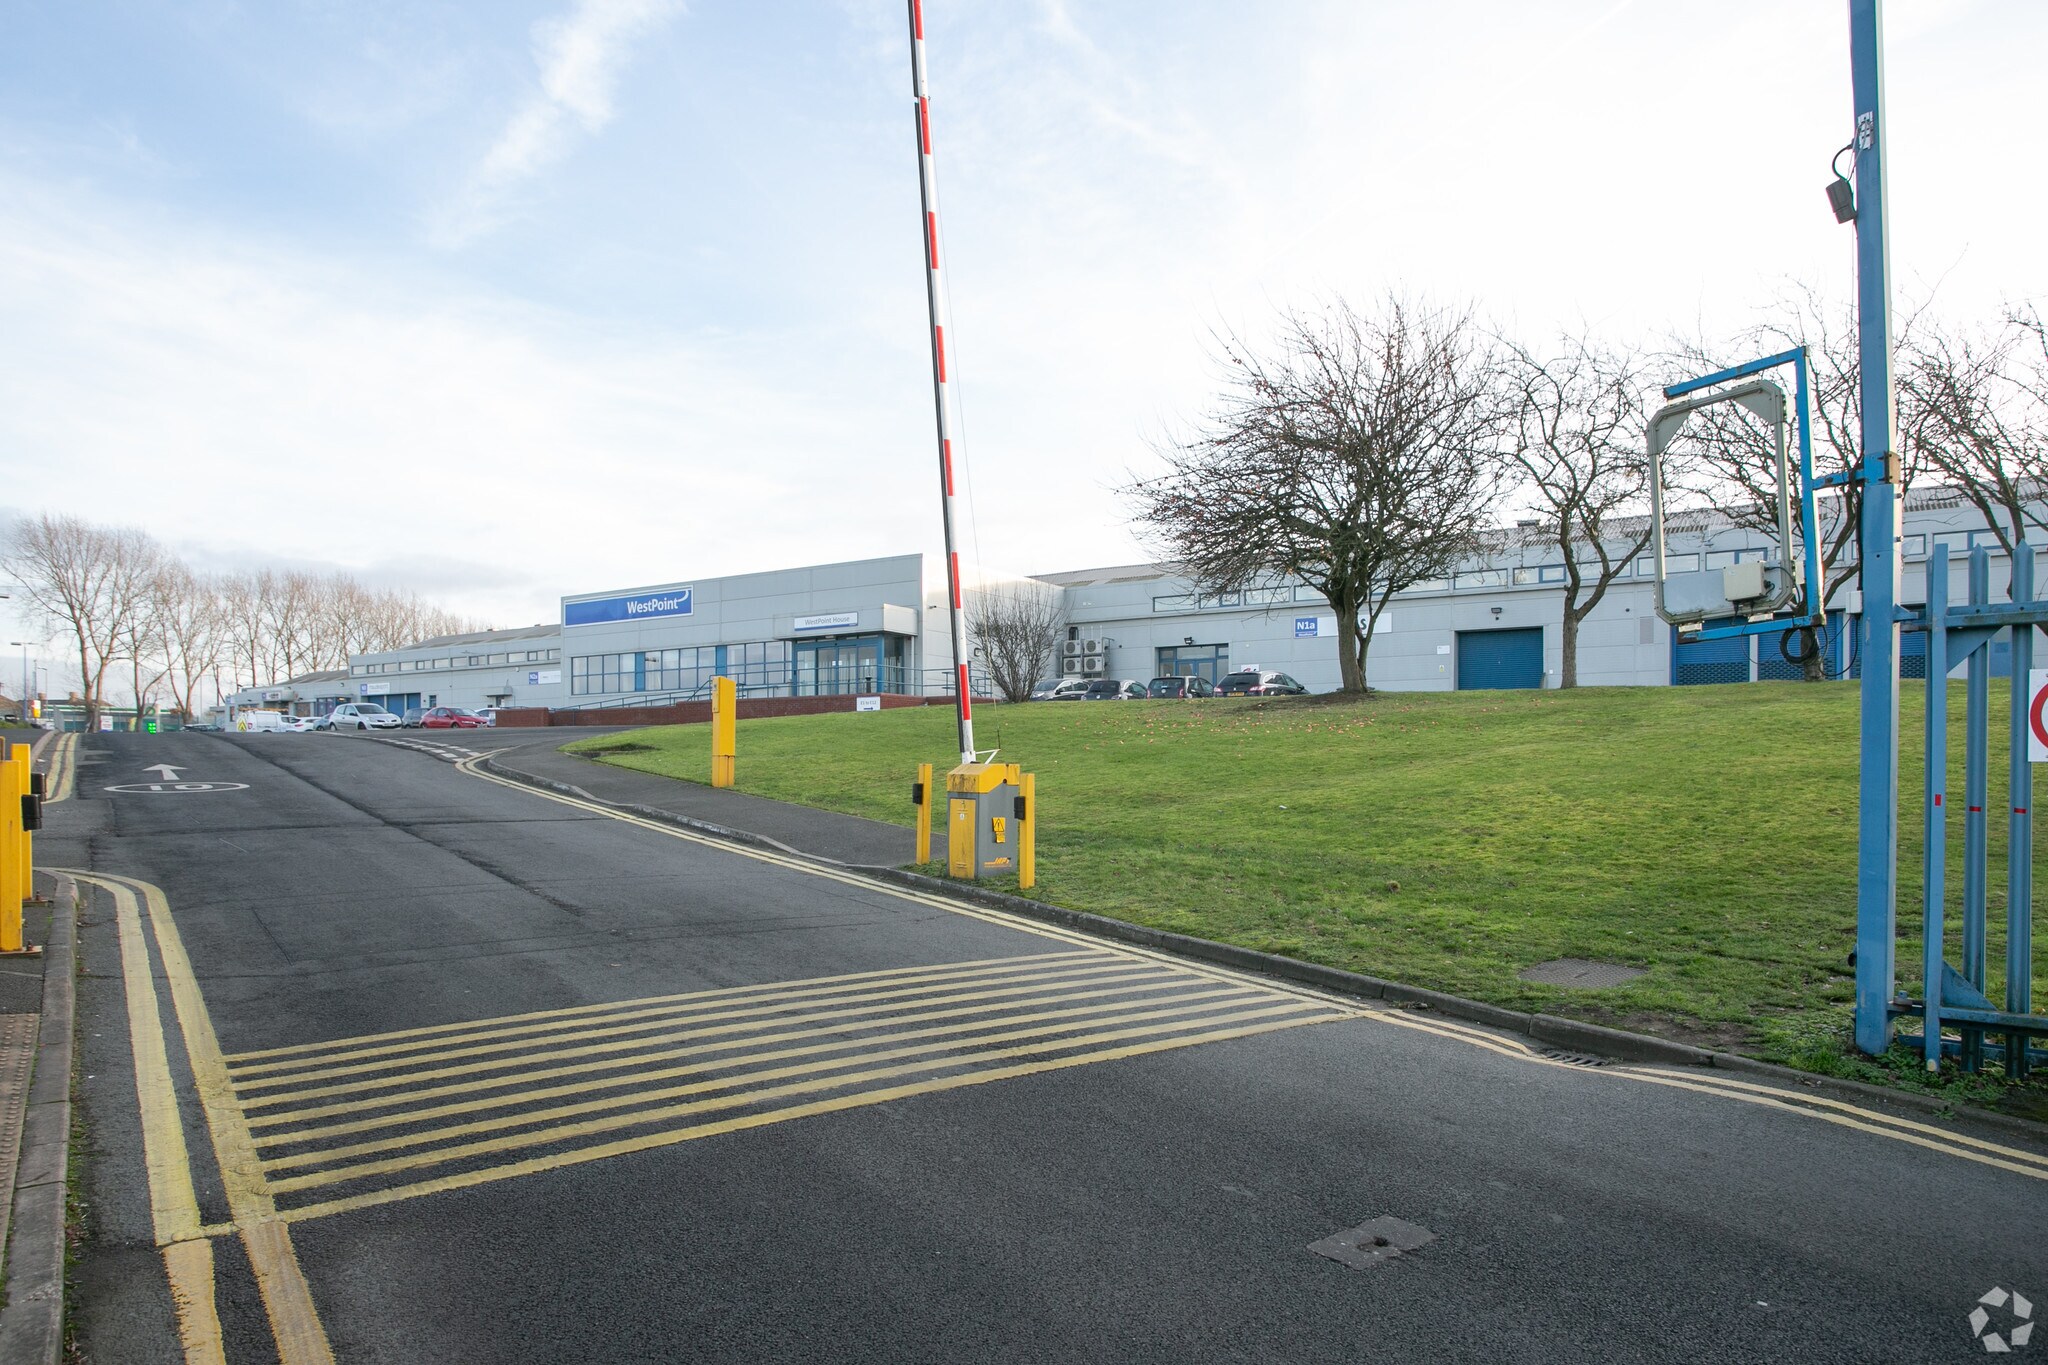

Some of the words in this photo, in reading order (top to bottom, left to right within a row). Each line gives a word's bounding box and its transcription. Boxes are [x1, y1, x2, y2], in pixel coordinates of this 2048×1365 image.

[626, 597, 679, 614] WestPoint
[804, 617, 832, 626] WestPoint
[832, 616, 850, 624] House
[1297, 621, 1316, 630] N1a
